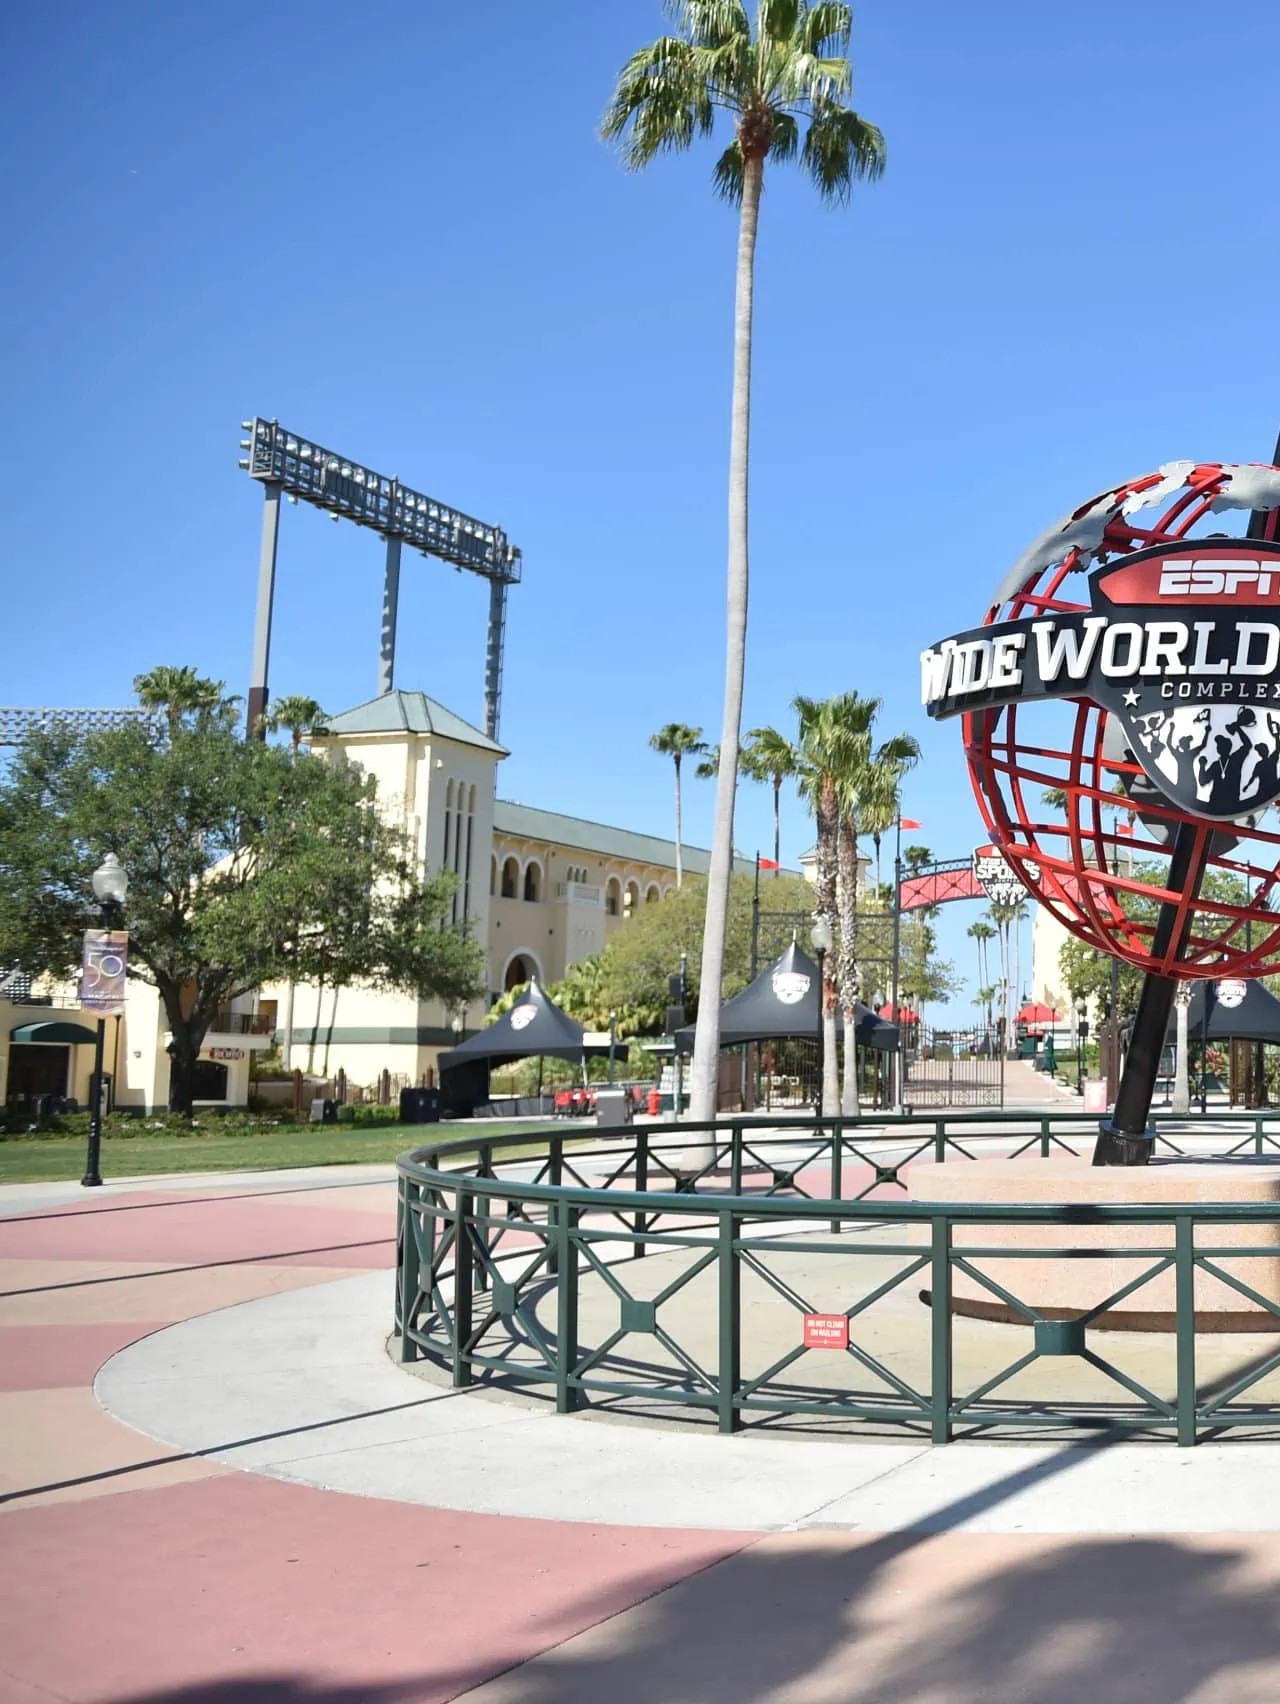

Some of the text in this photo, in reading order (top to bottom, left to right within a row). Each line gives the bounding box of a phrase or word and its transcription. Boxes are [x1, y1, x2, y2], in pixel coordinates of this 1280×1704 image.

[920, 633, 1026, 705] WIDE
[1031, 616, 1280, 681] WORLD
[87, 952, 123, 987] 50
